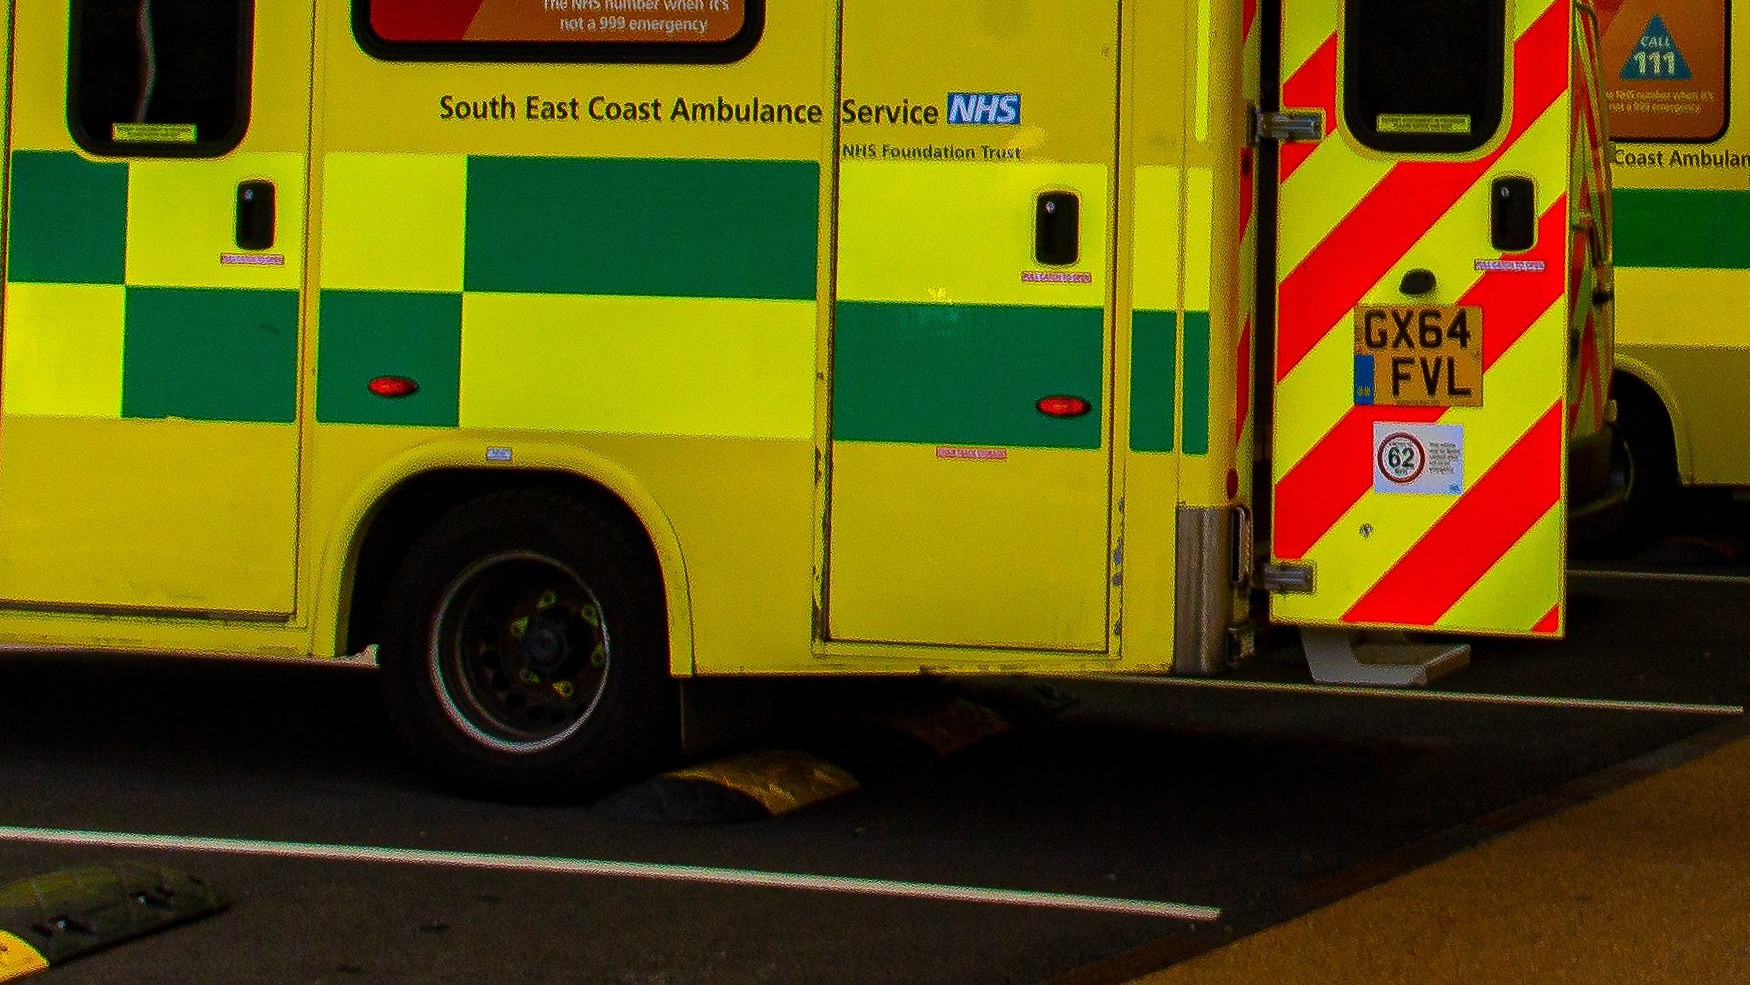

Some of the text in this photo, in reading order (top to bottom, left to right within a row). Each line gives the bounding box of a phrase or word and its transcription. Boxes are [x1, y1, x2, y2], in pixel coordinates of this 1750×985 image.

[560, 17, 708, 34] not a 999 emergency
[1640, 35, 1671, 48] CALL
[1634, 51, 1677, 74] 111
[439, 94, 1019, 125] South East Coast Ambulance Service NHS
[842, 143, 1022, 160] NHS Foundation Trust
[1613, 149, 1662, 168] Coast
[1363, 309, 1471, 350] GX64
[1391, 356, 1472, 397] FVL
[1387, 446, 1415, 469] 62
